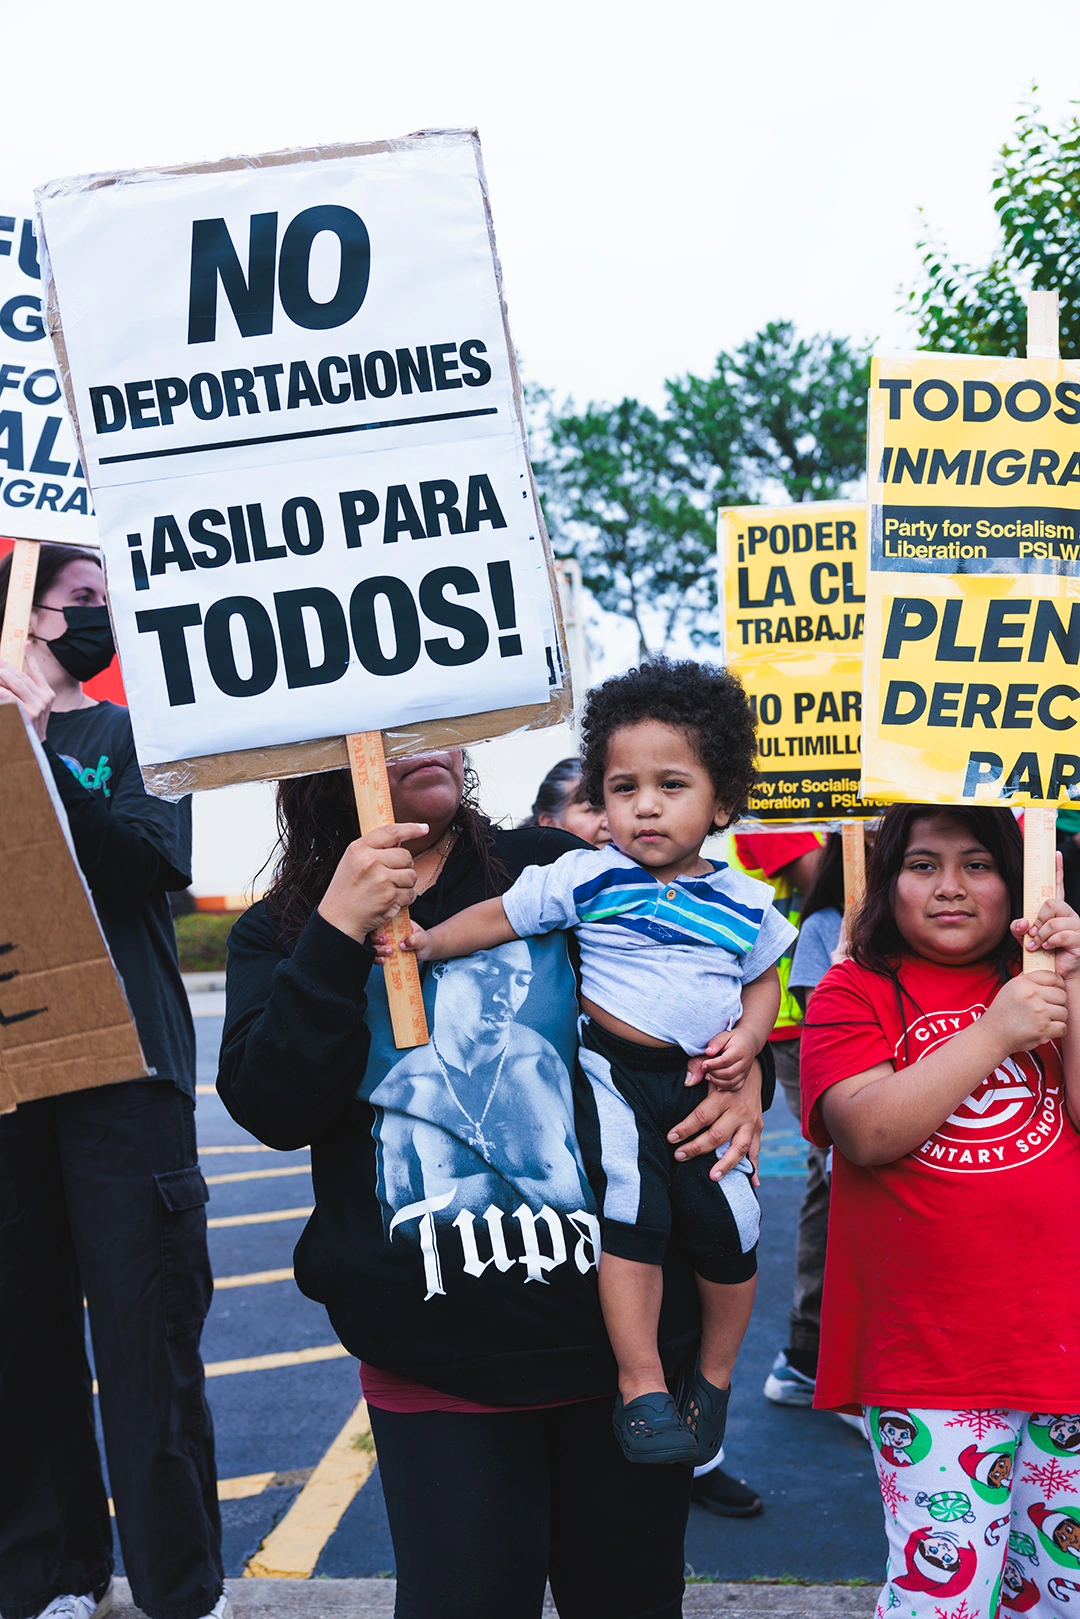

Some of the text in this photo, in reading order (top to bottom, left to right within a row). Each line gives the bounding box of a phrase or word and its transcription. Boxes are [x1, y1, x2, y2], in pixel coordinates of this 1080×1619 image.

[188, 204, 371, 344] NO
[88, 339, 492, 434] DEPORTACIONES
[879, 379, 1080, 425] TODOS
[0, 409, 85, 478] AL
[127, 473, 507, 591] ¡ASILO PARA
[737, 521, 857, 562] ¡PODER
[885, 518, 1075, 542] Party for Socialism
[885, 540, 1080, 561] Liberation PSLW
[738, 562, 865, 609] LA CL
[135, 559, 523, 707] TODOS!
[882, 597, 1080, 666] PLEN
[794, 691, 862, 724] PAR
[881, 680, 1080, 731] DEREC
[353, 737, 369, 786] PAINTS
[758, 734, 862, 757] ULTIMILL
[778, 780, 799, 793] for
[801, 778, 860, 793] Socialis
[962, 751, 1080, 801] PAR
[915, 1018, 960, 1041] CITY
[920, 1086, 1059, 1163] ENTARY SCHOOL
[389, 1184, 602, 1301] Tupa
